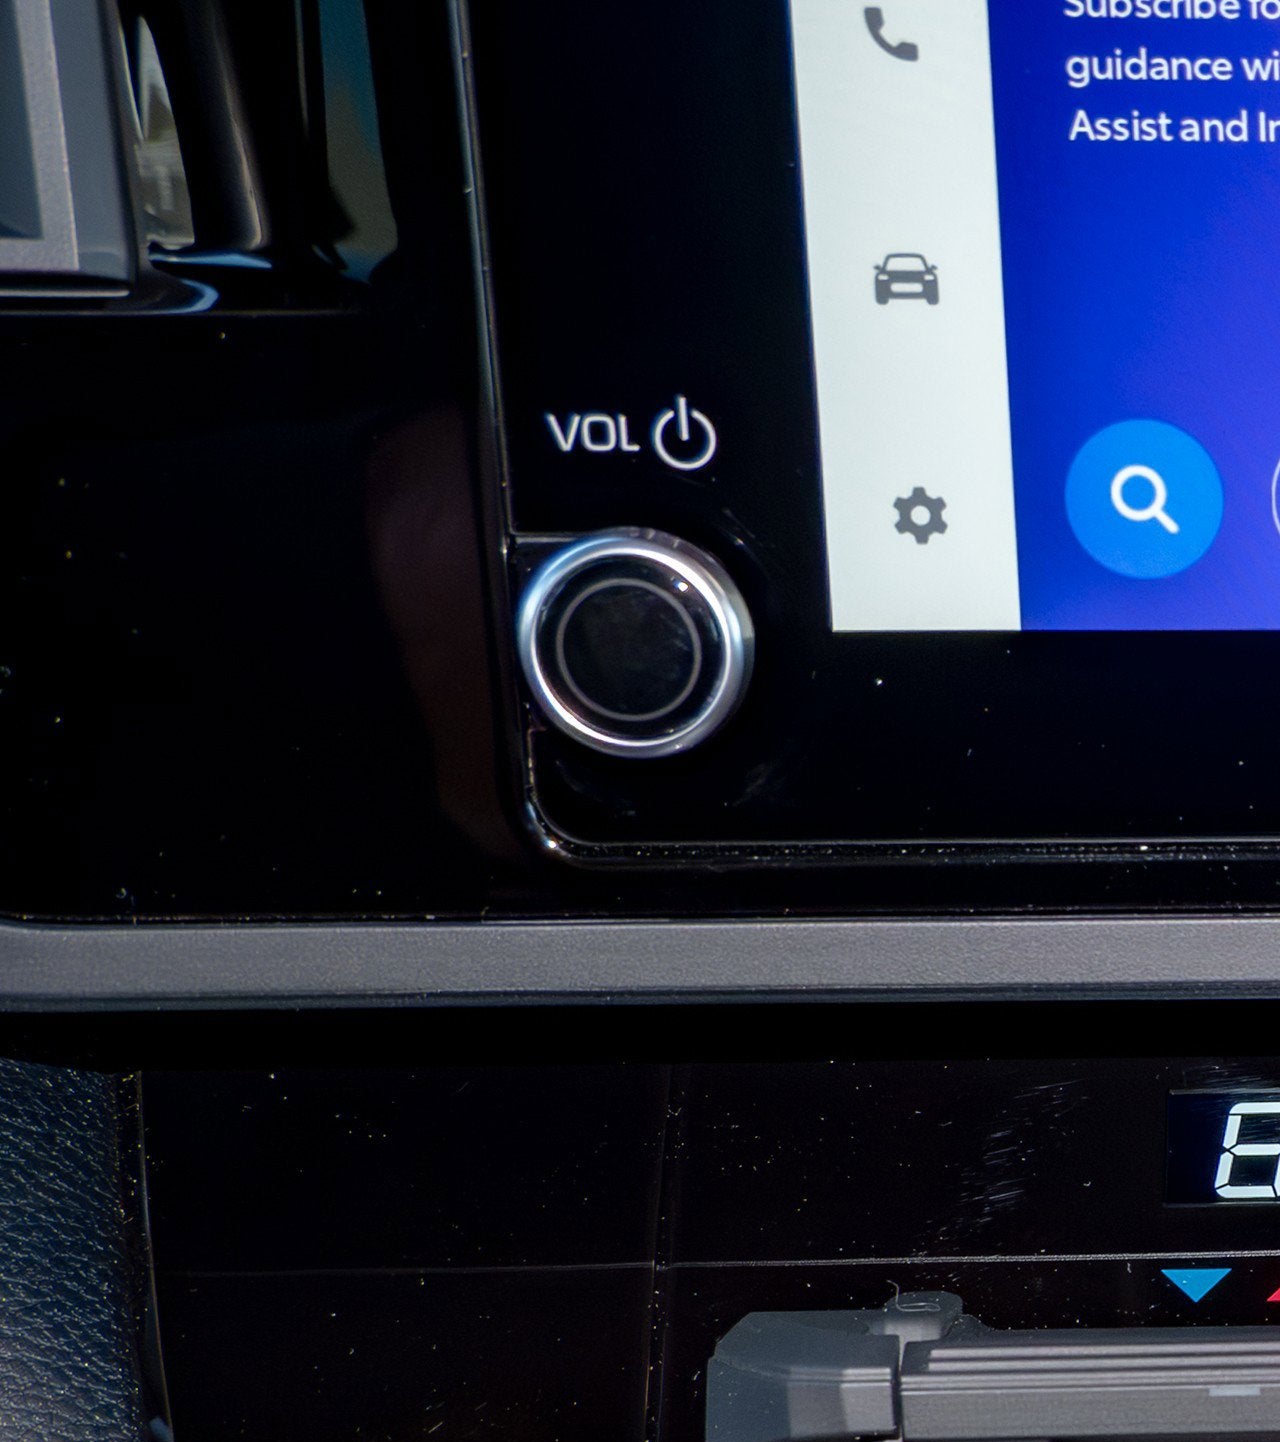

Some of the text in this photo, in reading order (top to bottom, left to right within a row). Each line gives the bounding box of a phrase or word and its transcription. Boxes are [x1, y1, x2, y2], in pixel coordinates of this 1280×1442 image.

[1064, 0, 1240, 18] Subscribe
[1065, 47, 1233, 88] guidance
[1069, 109, 1173, 141] Assist
[1180, 109, 1248, 142] and
[546, 413, 641, 453] VOL
